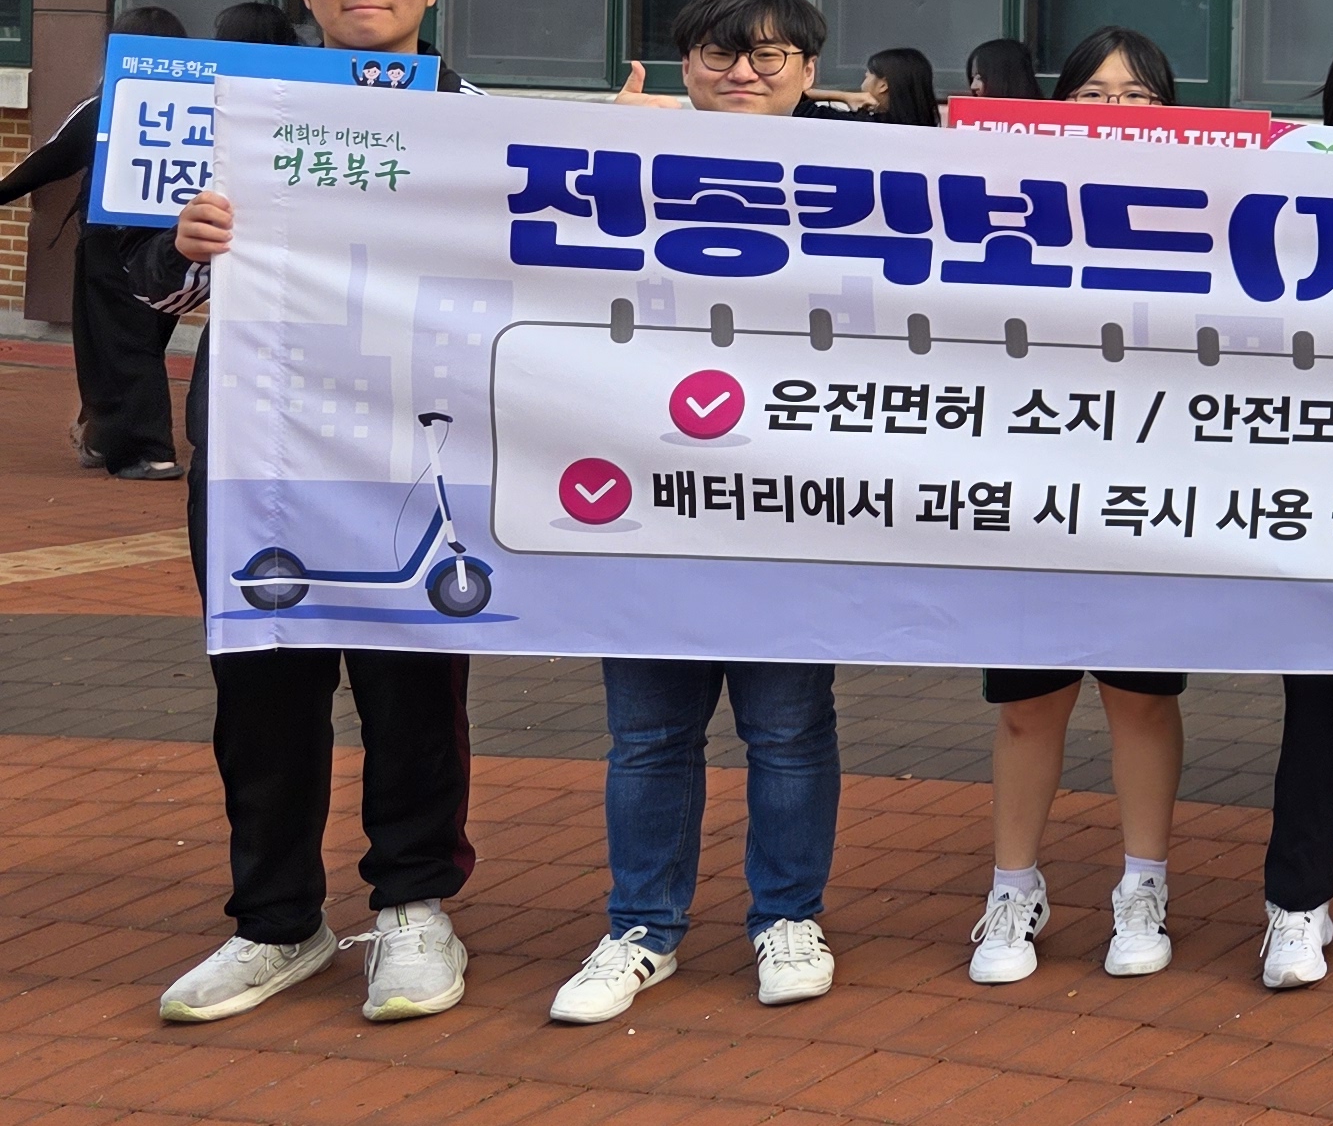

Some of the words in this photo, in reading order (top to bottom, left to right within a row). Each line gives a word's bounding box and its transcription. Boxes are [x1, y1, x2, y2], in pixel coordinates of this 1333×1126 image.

[122, 56, 218, 78] 매곡고등학교
[138, 101, 175, 148] 넌
[181, 105, 214, 146] 교
[272, 124, 330, 146] 새희망
[273, 147, 411, 192] 명품북구
[763, 379, 986, 438] 운전면허
[1007, 388, 1116, 442] 소지
[652, 470, 894, 528] 배터리에서
[915, 479, 1013, 532] 과열
[1033, 482, 1081, 535] 시
[1100, 485, 1197, 538] 즉시
[1216, 487, 1313, 541] 사용
